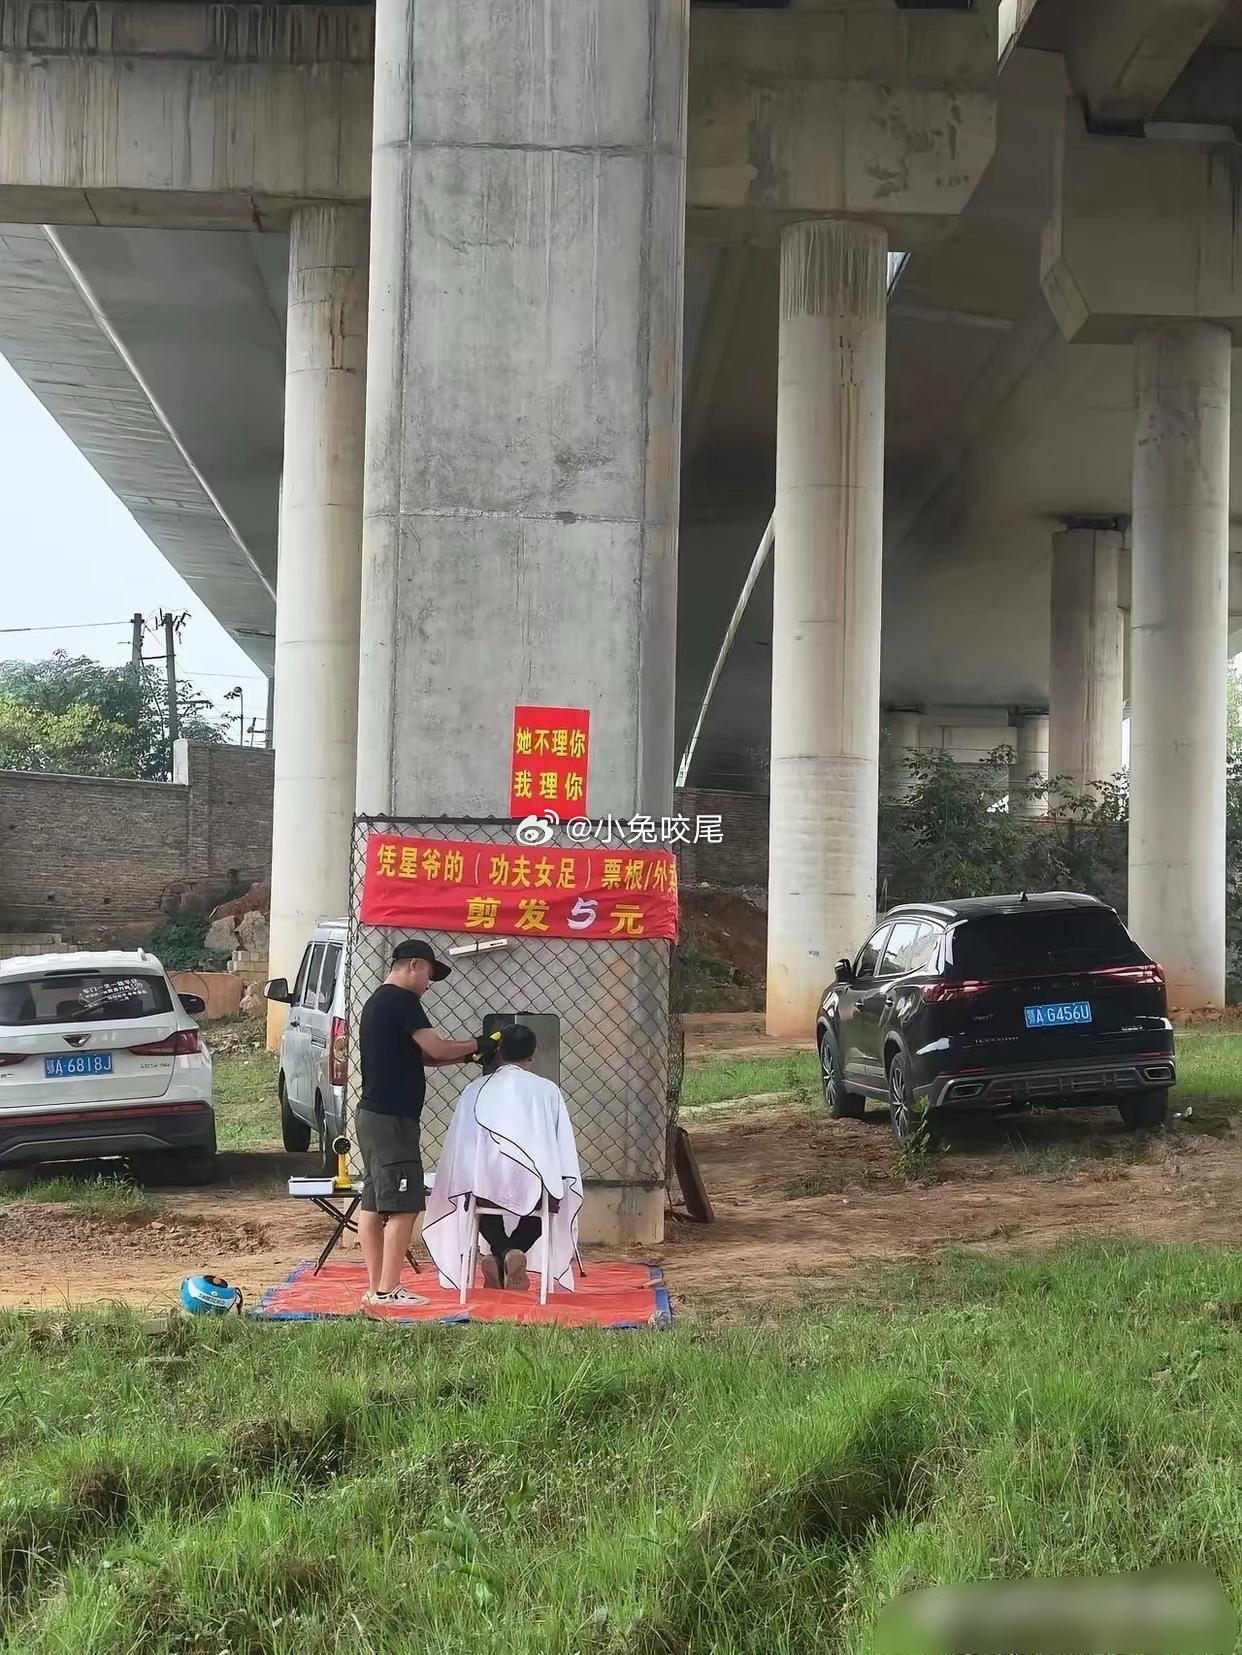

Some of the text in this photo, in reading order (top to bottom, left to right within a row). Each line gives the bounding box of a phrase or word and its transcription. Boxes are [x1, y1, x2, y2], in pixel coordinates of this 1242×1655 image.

[516, 727, 586, 758] 她不理你
[514, 770, 583, 801] 我理你
[464, 896, 644, 936] 剪发5元
